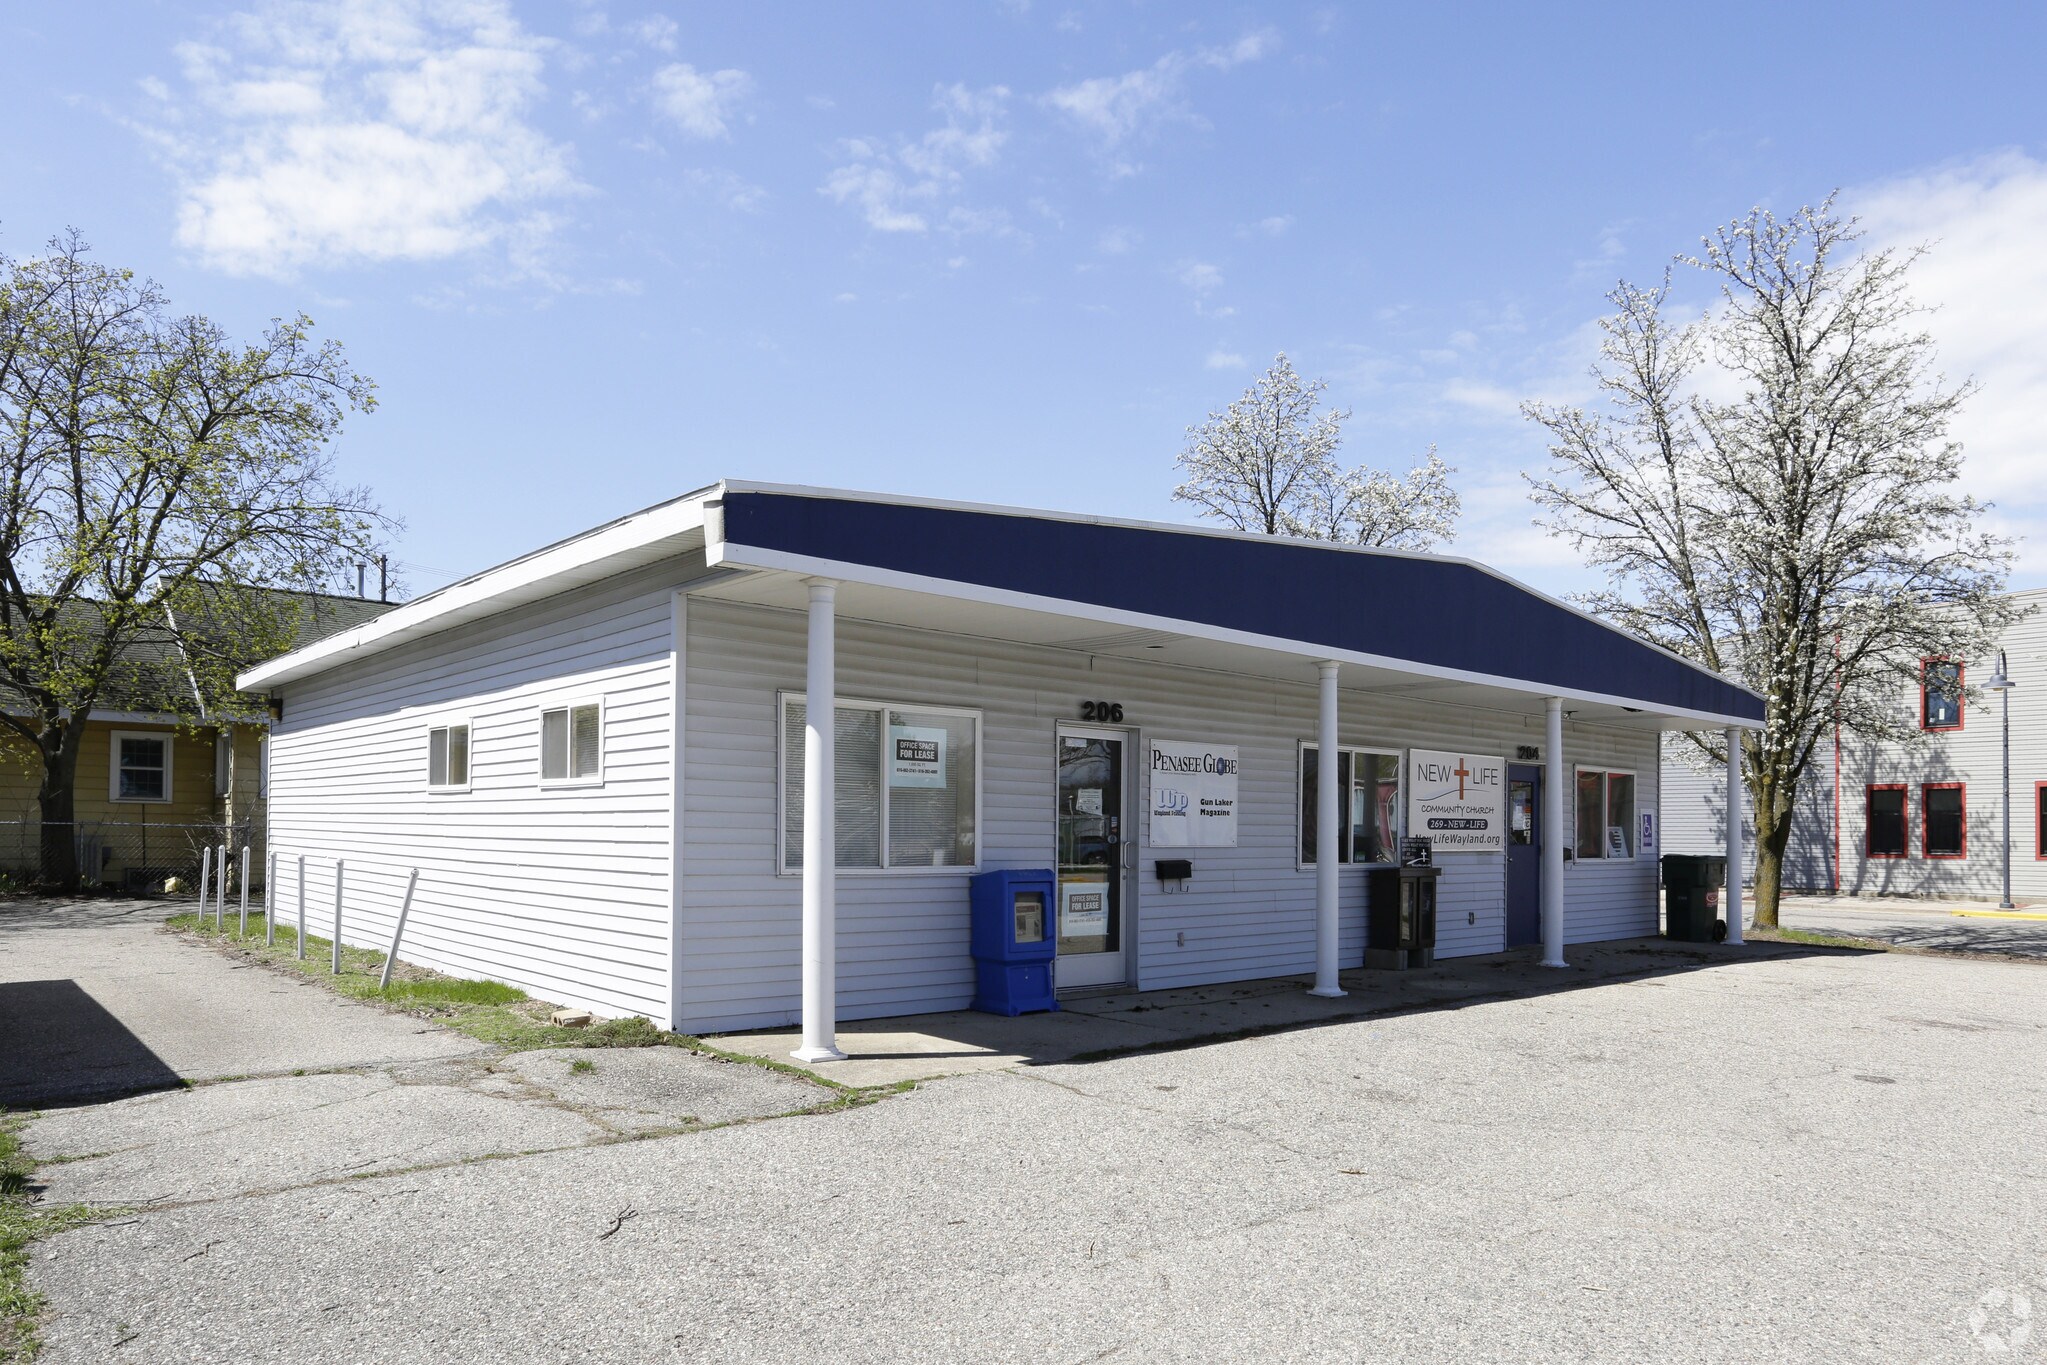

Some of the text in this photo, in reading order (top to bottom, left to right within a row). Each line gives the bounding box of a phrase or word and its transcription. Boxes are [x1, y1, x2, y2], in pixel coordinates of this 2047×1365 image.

[1083, 701, 1123, 722] 206
[900, 741, 935, 750] OFFICE SPACE
[900, 749, 935, 760] FOR LEASE
[1517, 746, 1540, 760] 204
[1152, 749, 1238, 776] PENASEE GLOBE
[1417, 763, 1498, 786] NEW LIFE
[1200, 798, 1233, 807] Gun Laker
[1200, 809, 1231, 817] Magazine
[1421, 803, 1495, 817] COMMUNITY CHURCH
[1415, 833, 1500, 845] LifeWayland.org
[1083, 902, 1099, 910] LEASE
